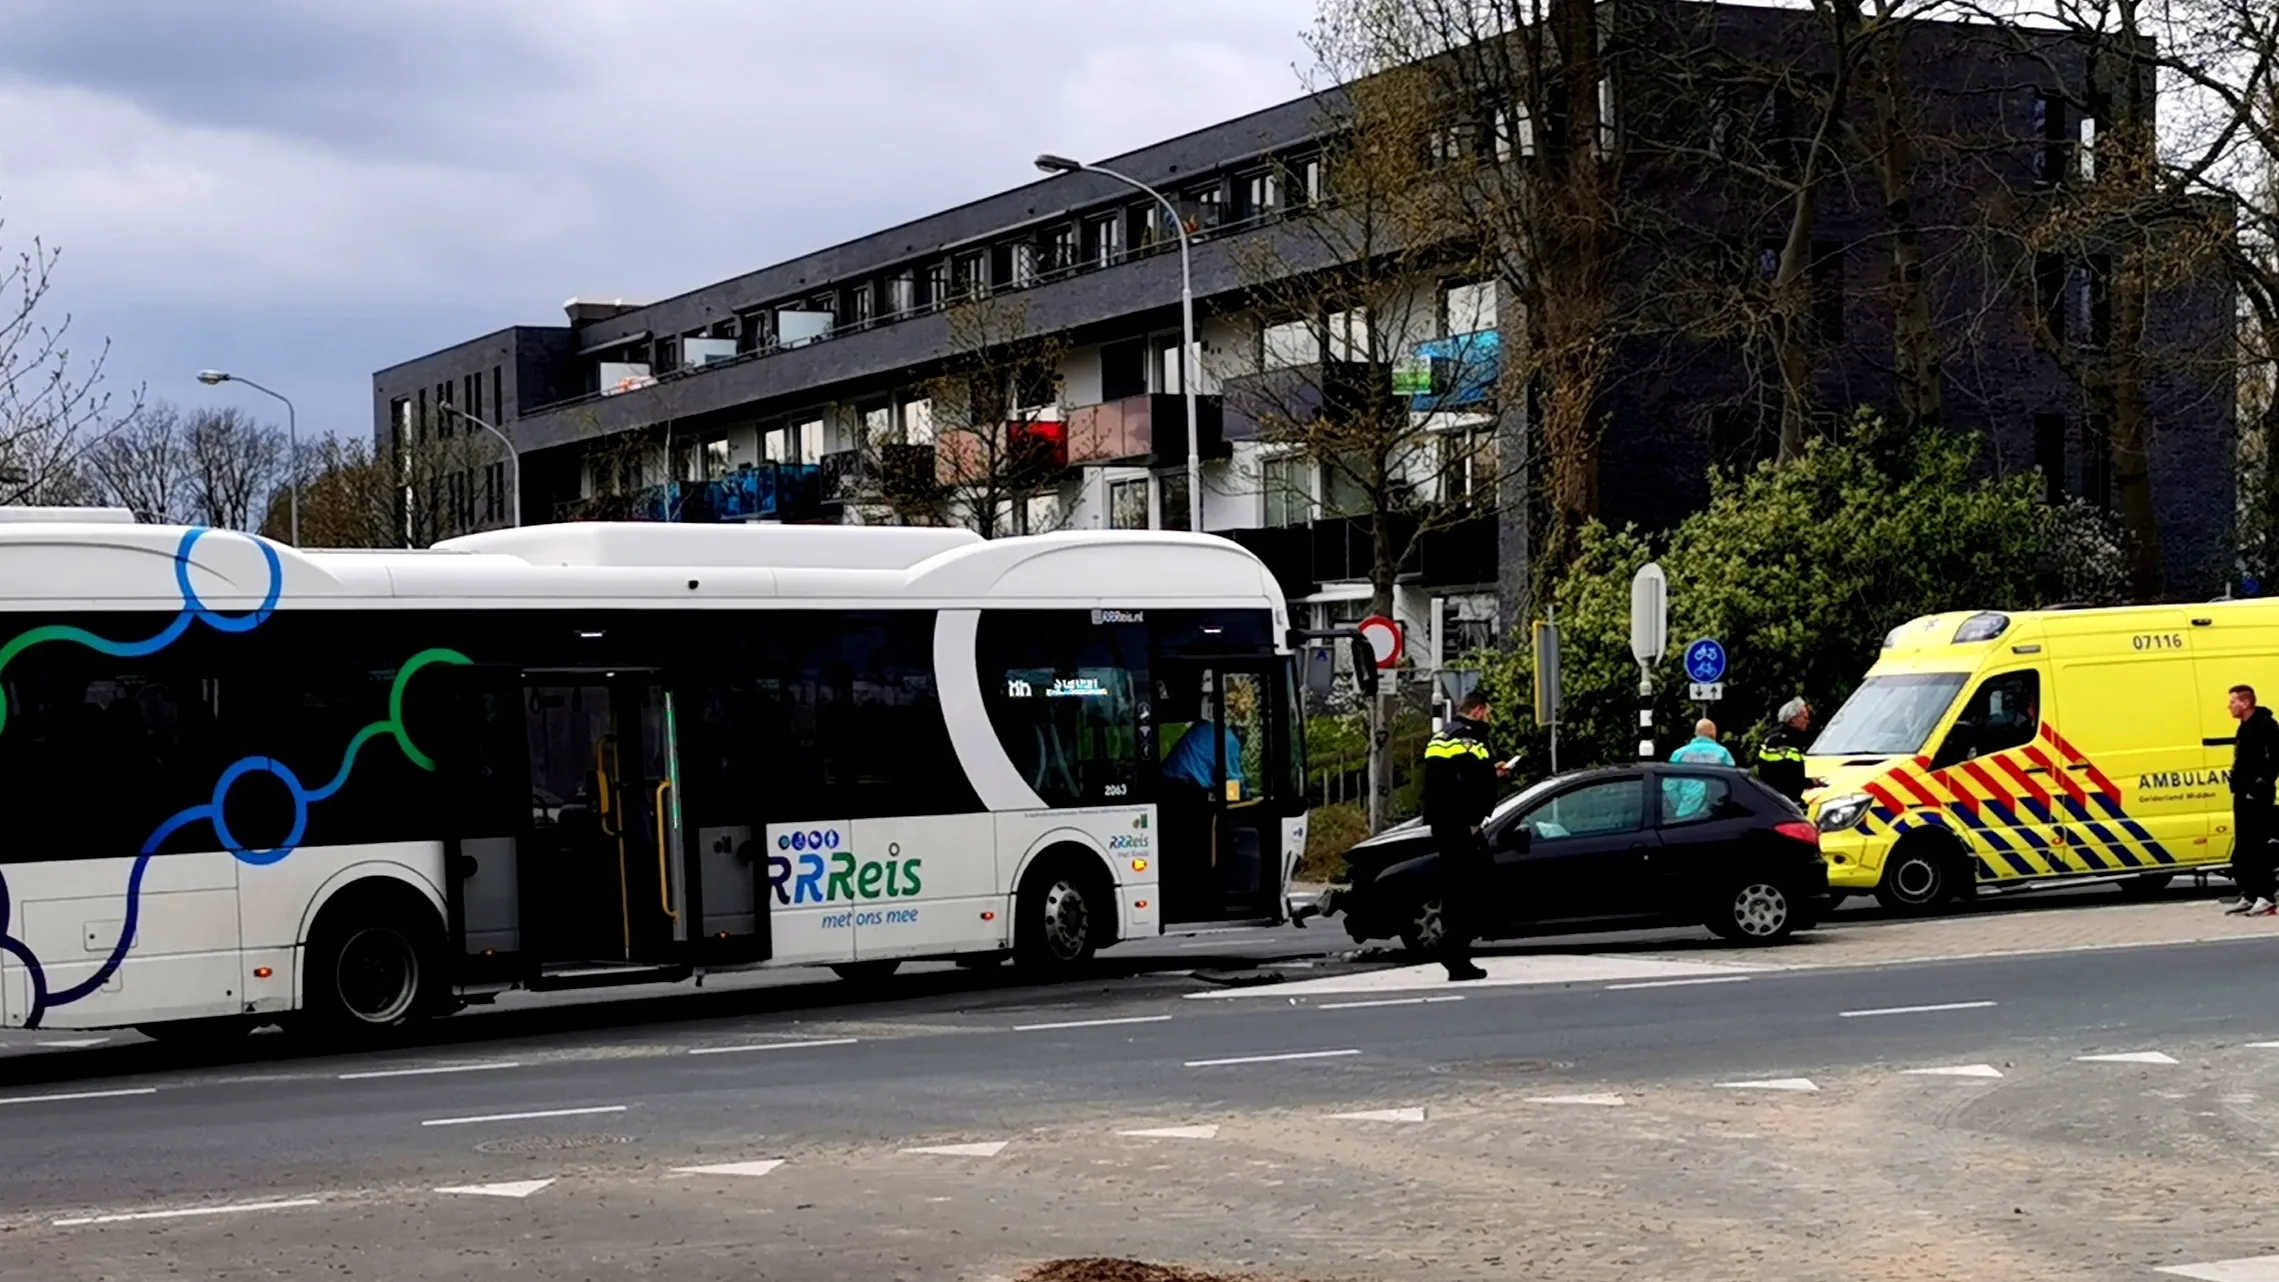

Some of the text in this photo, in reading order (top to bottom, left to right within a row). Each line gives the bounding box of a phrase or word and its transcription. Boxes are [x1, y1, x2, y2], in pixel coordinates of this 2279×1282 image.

[2132, 633, 2183, 650] 07116
[1104, 783, 1128, 796] 2063
[767, 842, 922, 905] RRReis
[821, 908, 919, 929] met ons mee
